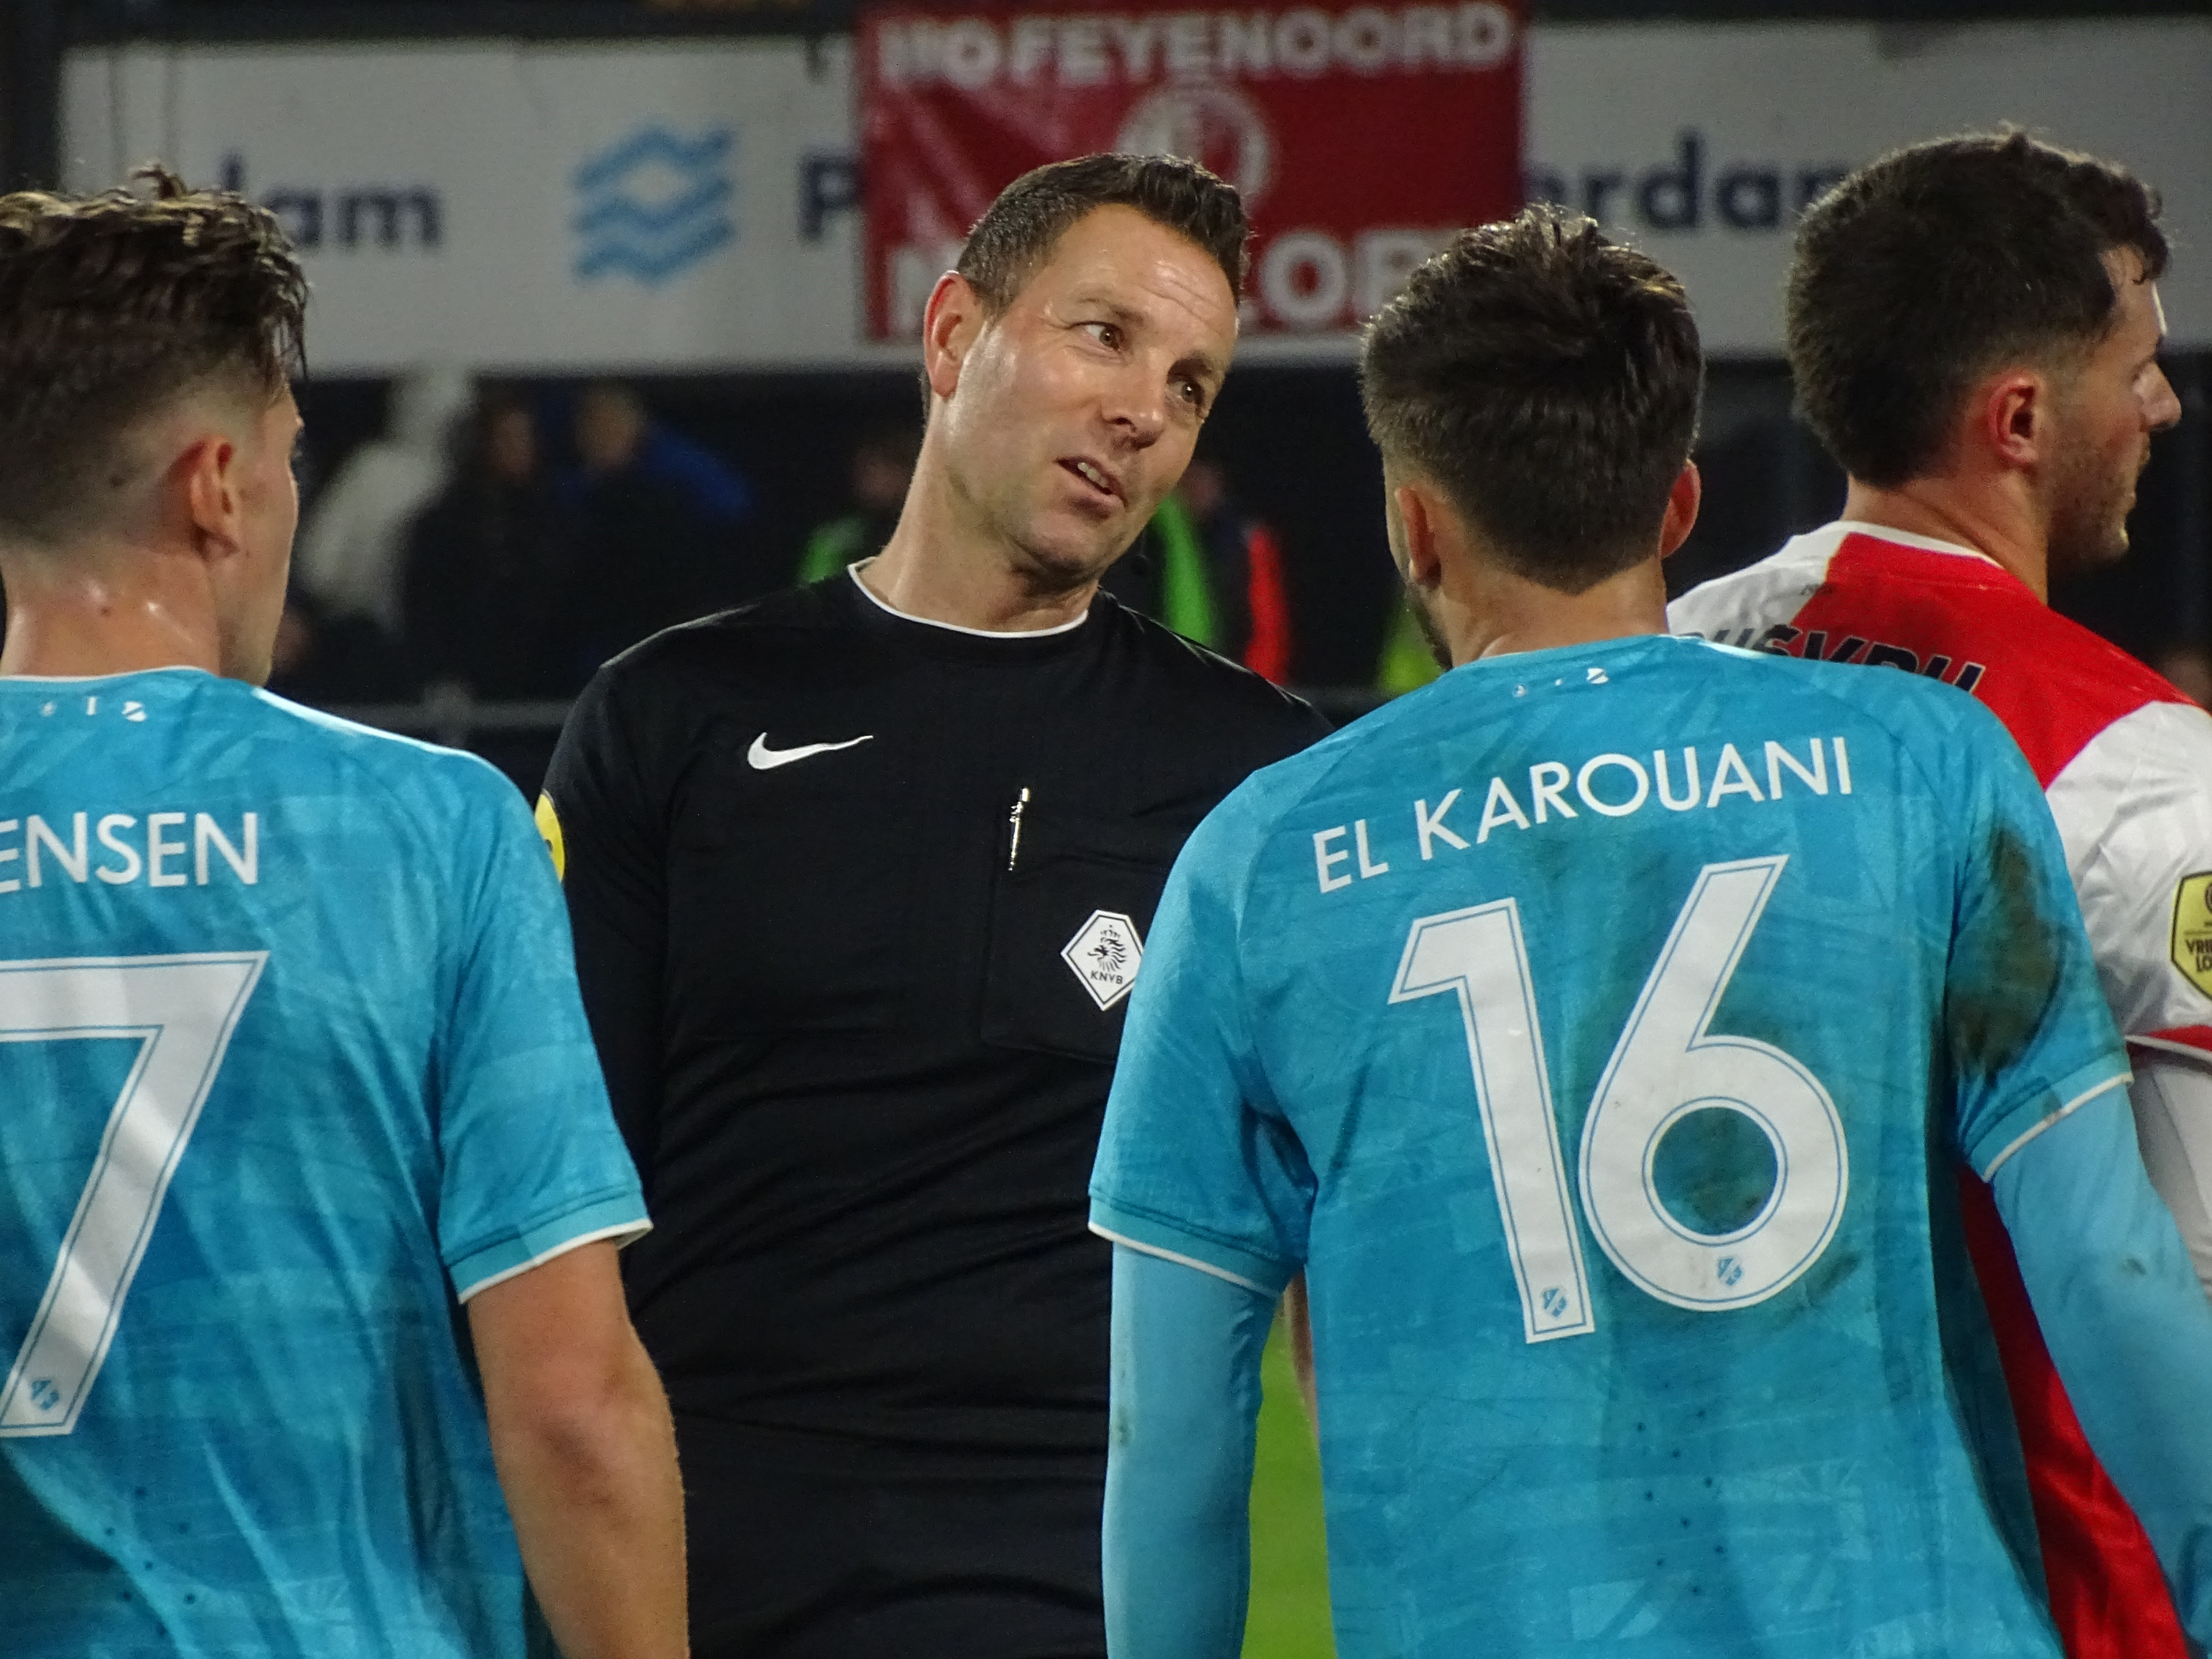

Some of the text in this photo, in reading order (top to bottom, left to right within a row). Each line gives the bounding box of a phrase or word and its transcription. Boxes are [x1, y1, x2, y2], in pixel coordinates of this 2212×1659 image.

[1313, 736, 1853, 893] EL KAROUANI
[1090, 970, 1123, 984] KNVB
[1387, 854, 1850, 1344] 16
[0, 950, 270, 1438] 7
